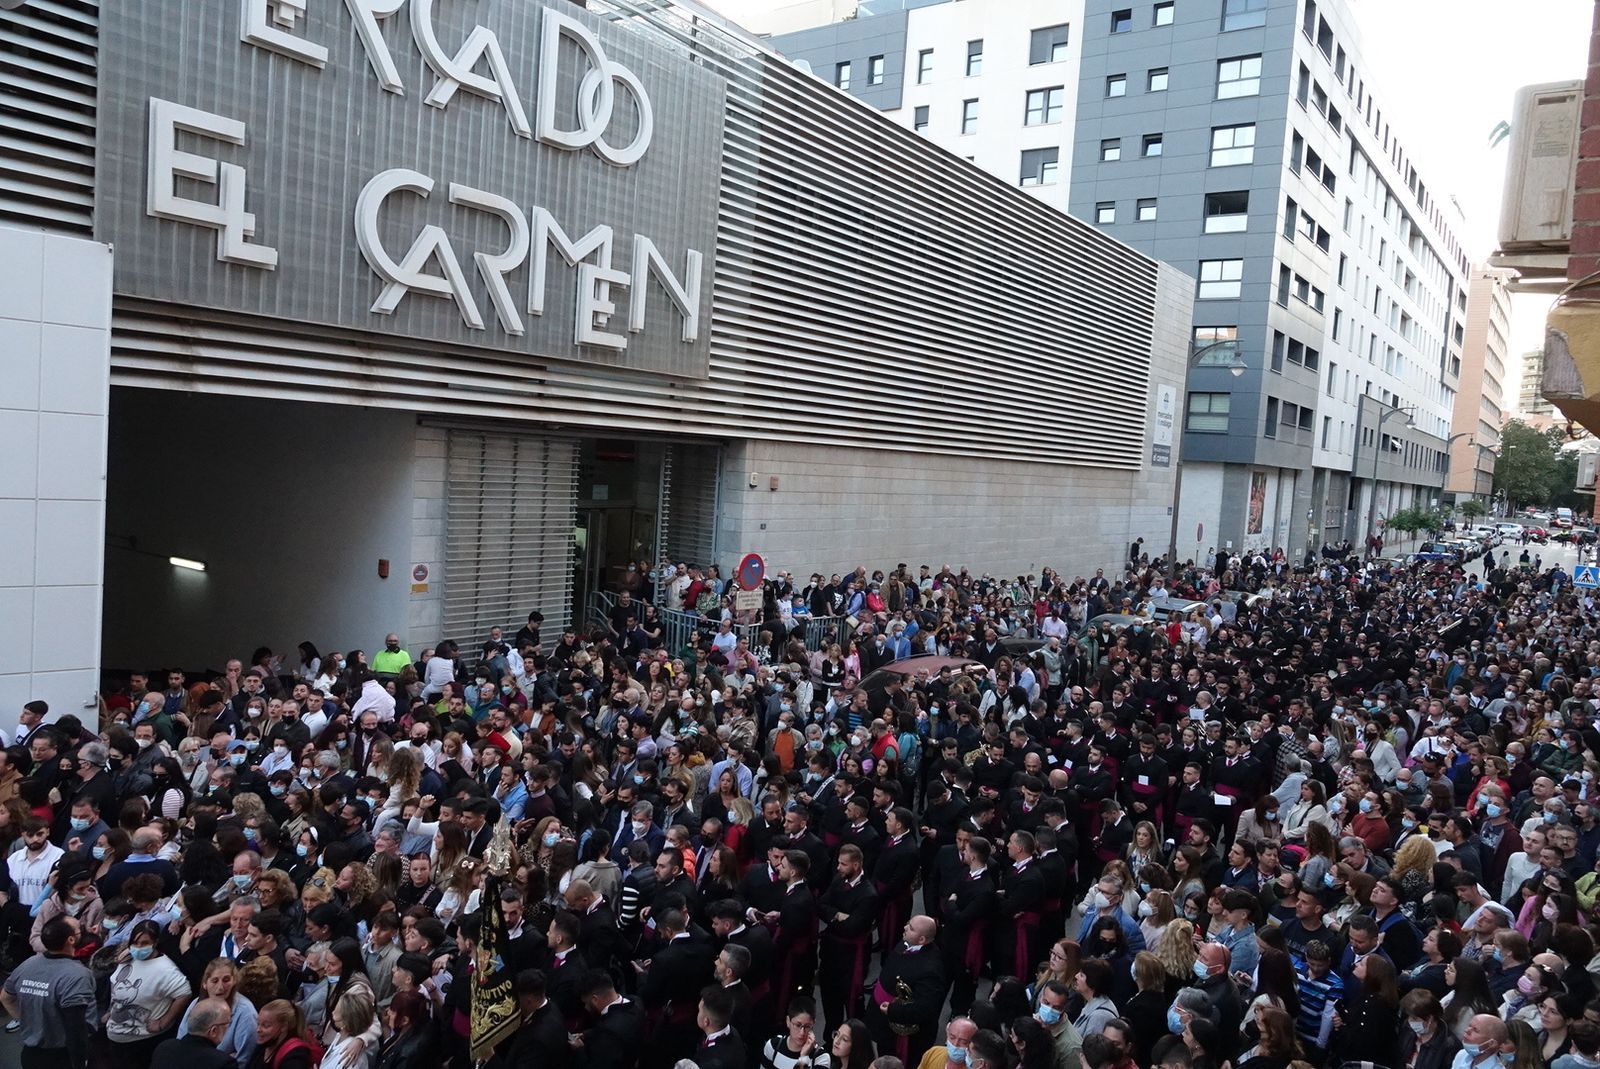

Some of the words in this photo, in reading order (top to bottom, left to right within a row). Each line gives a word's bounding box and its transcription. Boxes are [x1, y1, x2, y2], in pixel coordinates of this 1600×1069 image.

[241, 0, 653, 167] ERCADO
[147, 96, 278, 270] EL
[354, 168, 702, 352] CARMEN
[22, 979, 50, 989] SERVICIOS
[477, 980, 512, 999] CAUTIVO
